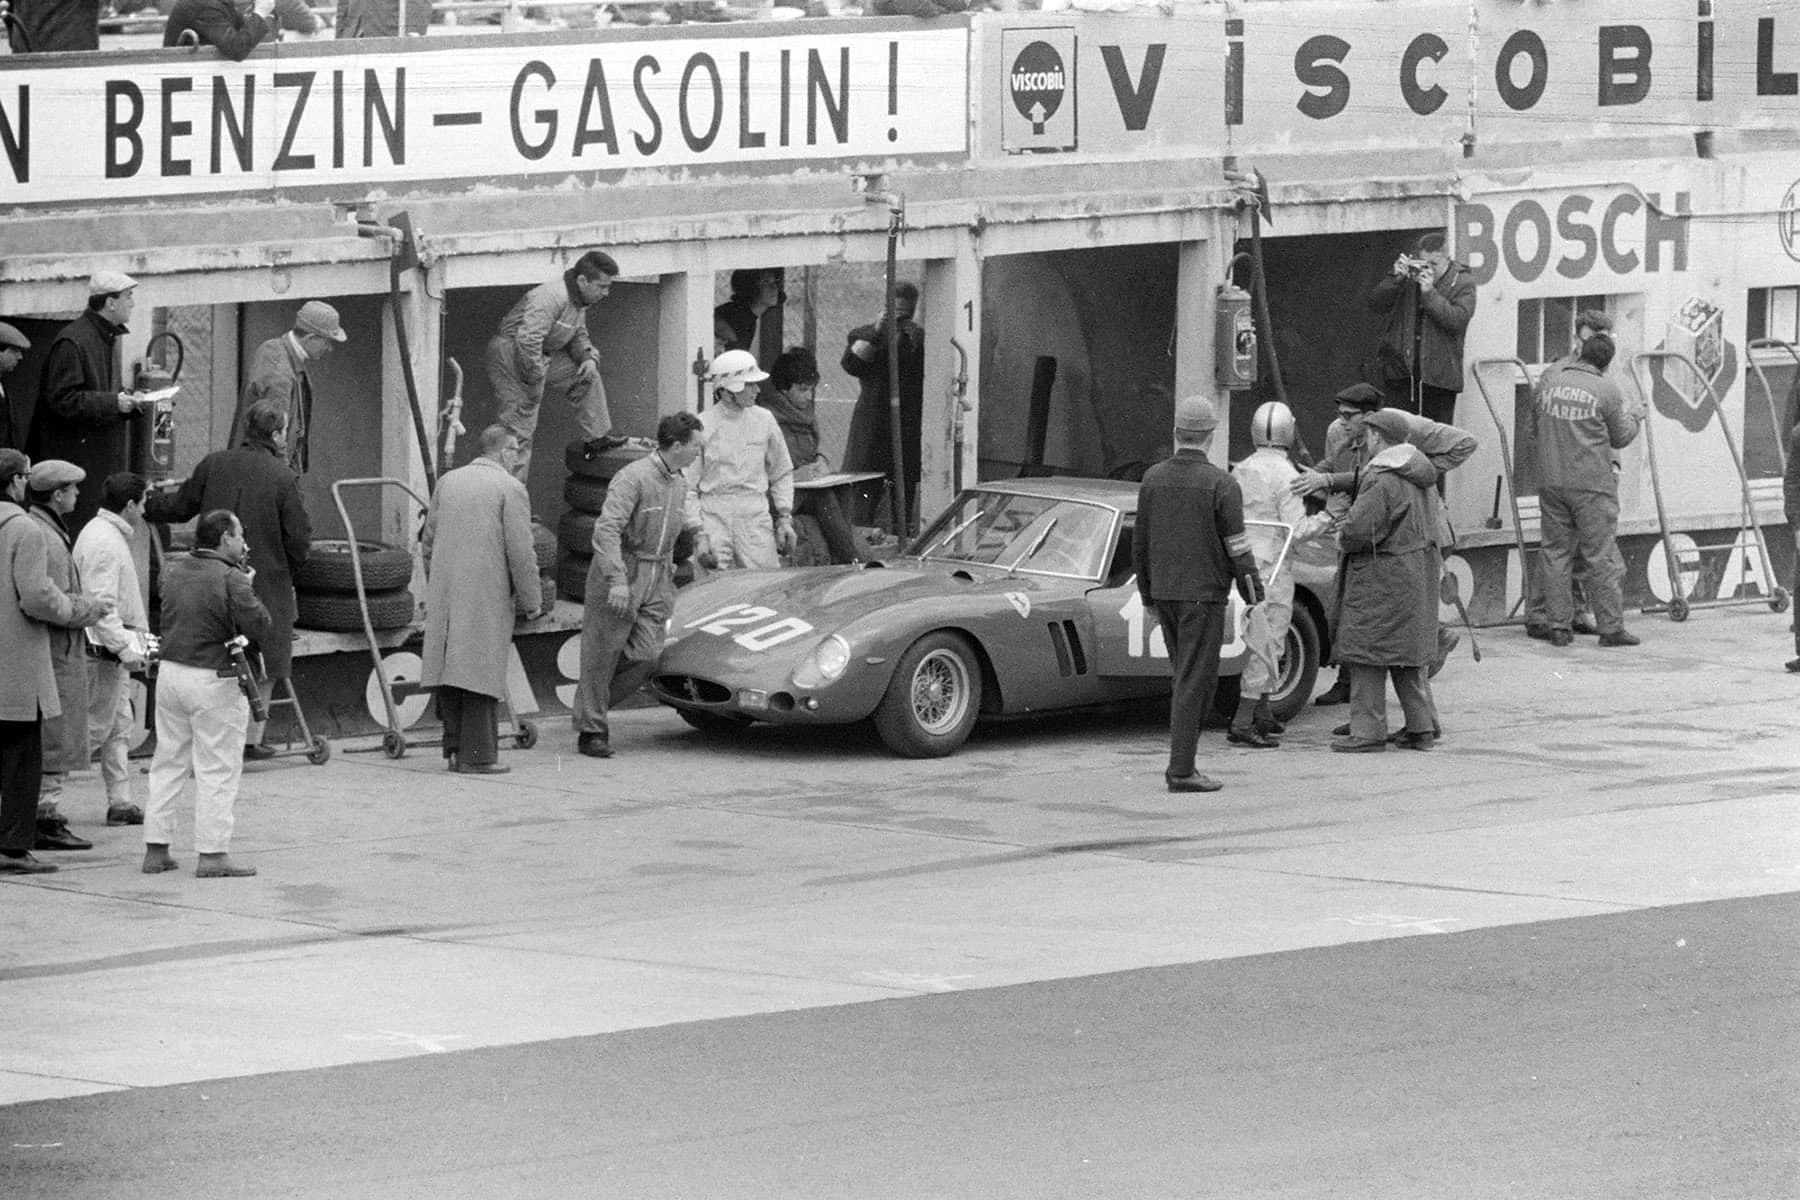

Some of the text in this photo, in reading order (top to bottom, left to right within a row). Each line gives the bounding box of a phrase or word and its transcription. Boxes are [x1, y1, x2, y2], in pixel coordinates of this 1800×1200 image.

[105, 67, 405, 179] BENZIN
[1455, 191, 1690, 286] BOSCH
[964, 300, 973, 332] 1
[683, 603, 814, 651] 120
